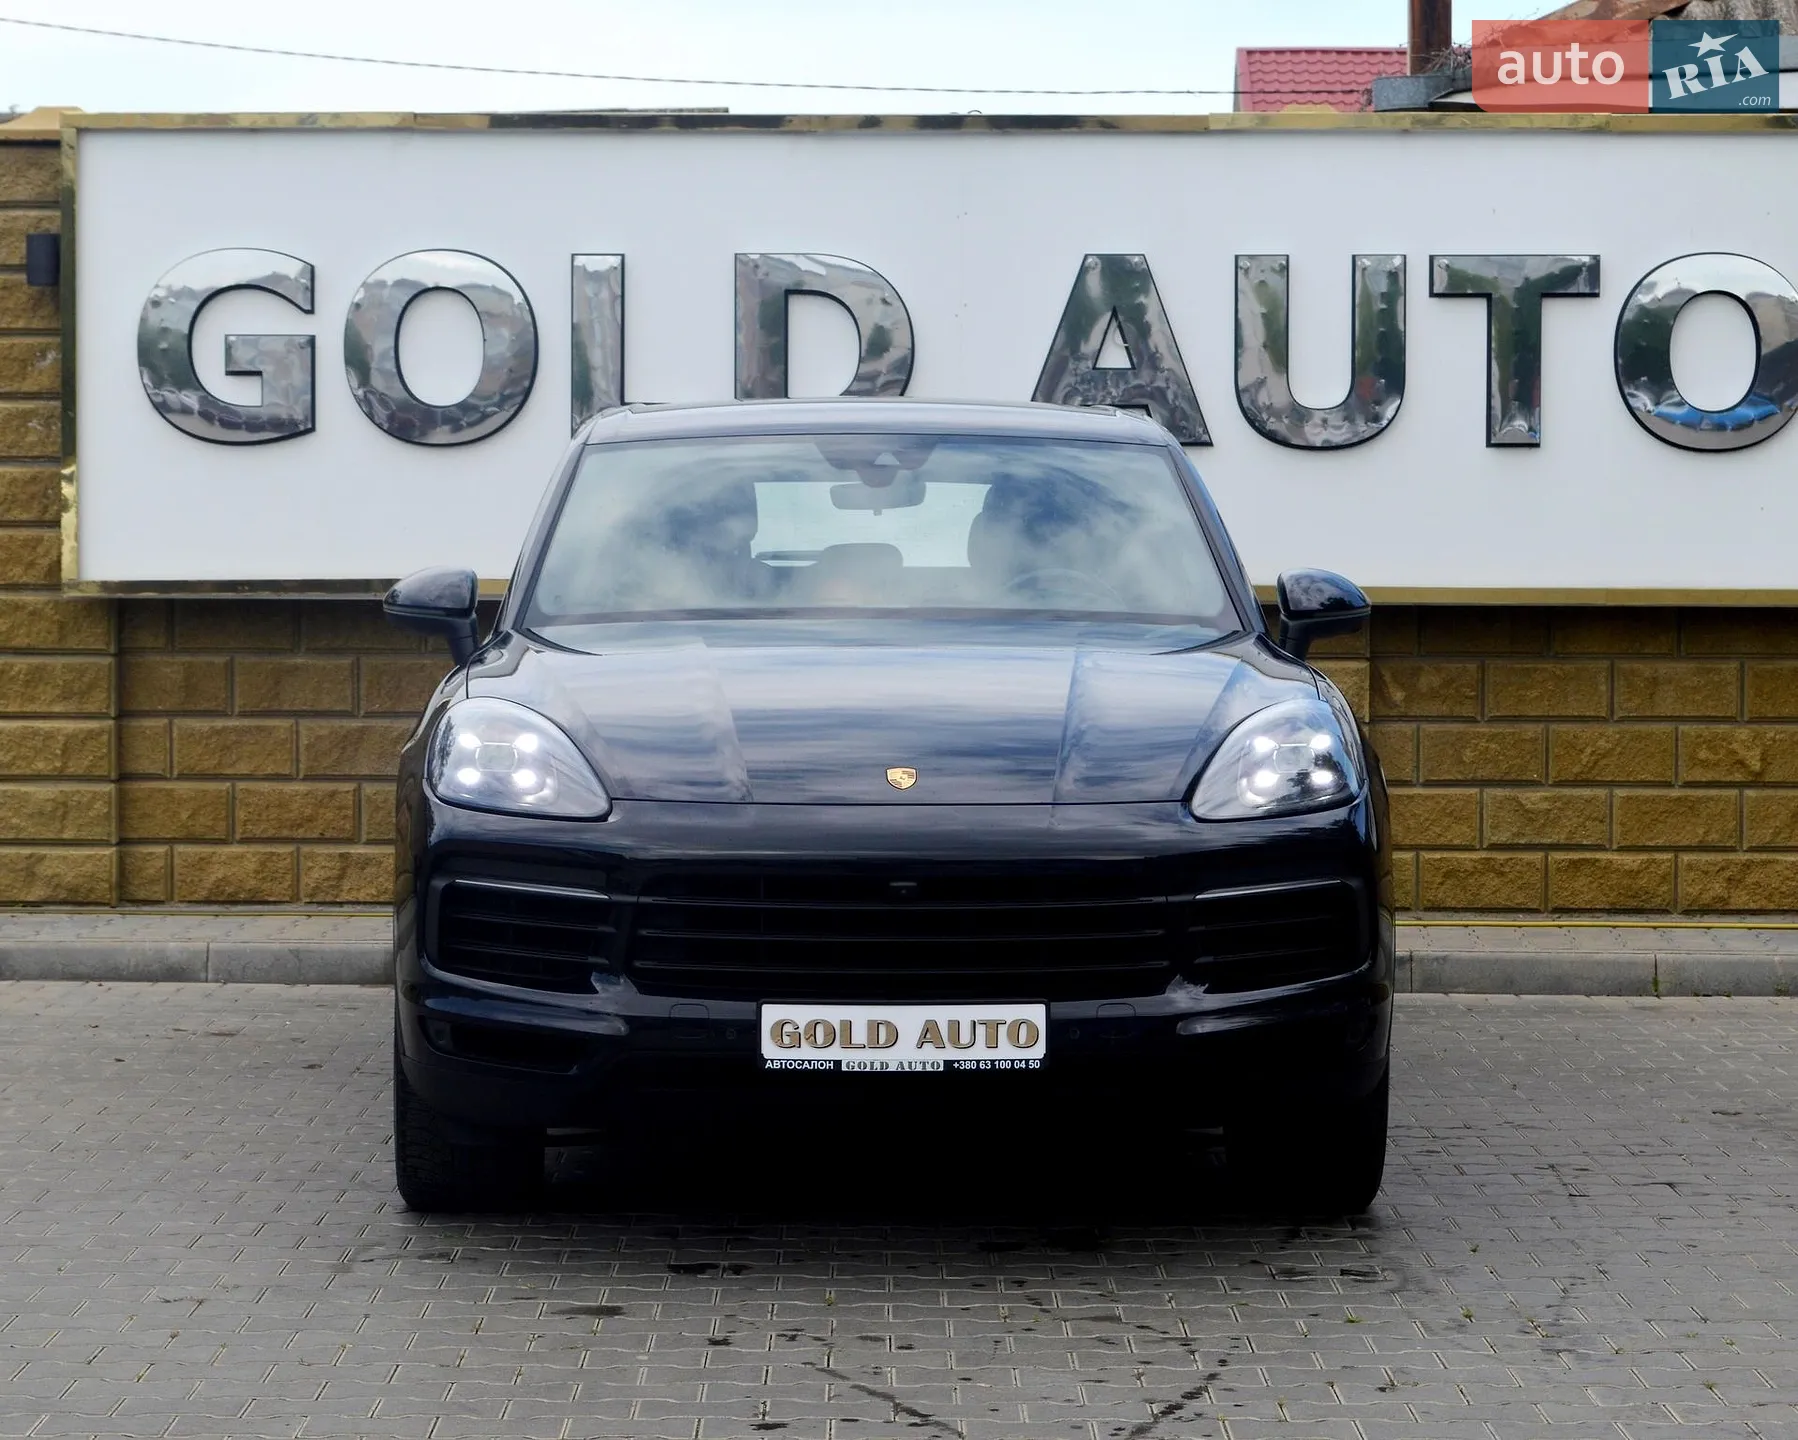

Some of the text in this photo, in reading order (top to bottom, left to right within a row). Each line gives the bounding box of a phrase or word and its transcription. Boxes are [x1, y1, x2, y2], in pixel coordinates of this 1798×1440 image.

[137, 247, 1798, 452] GOLD AUTO
[770, 1018, 1040, 1050] GOLD AUTO
[765, 1059, 1041, 1071] АВТОСАЛОН GOLD AUTO +380 63 100 04 50
